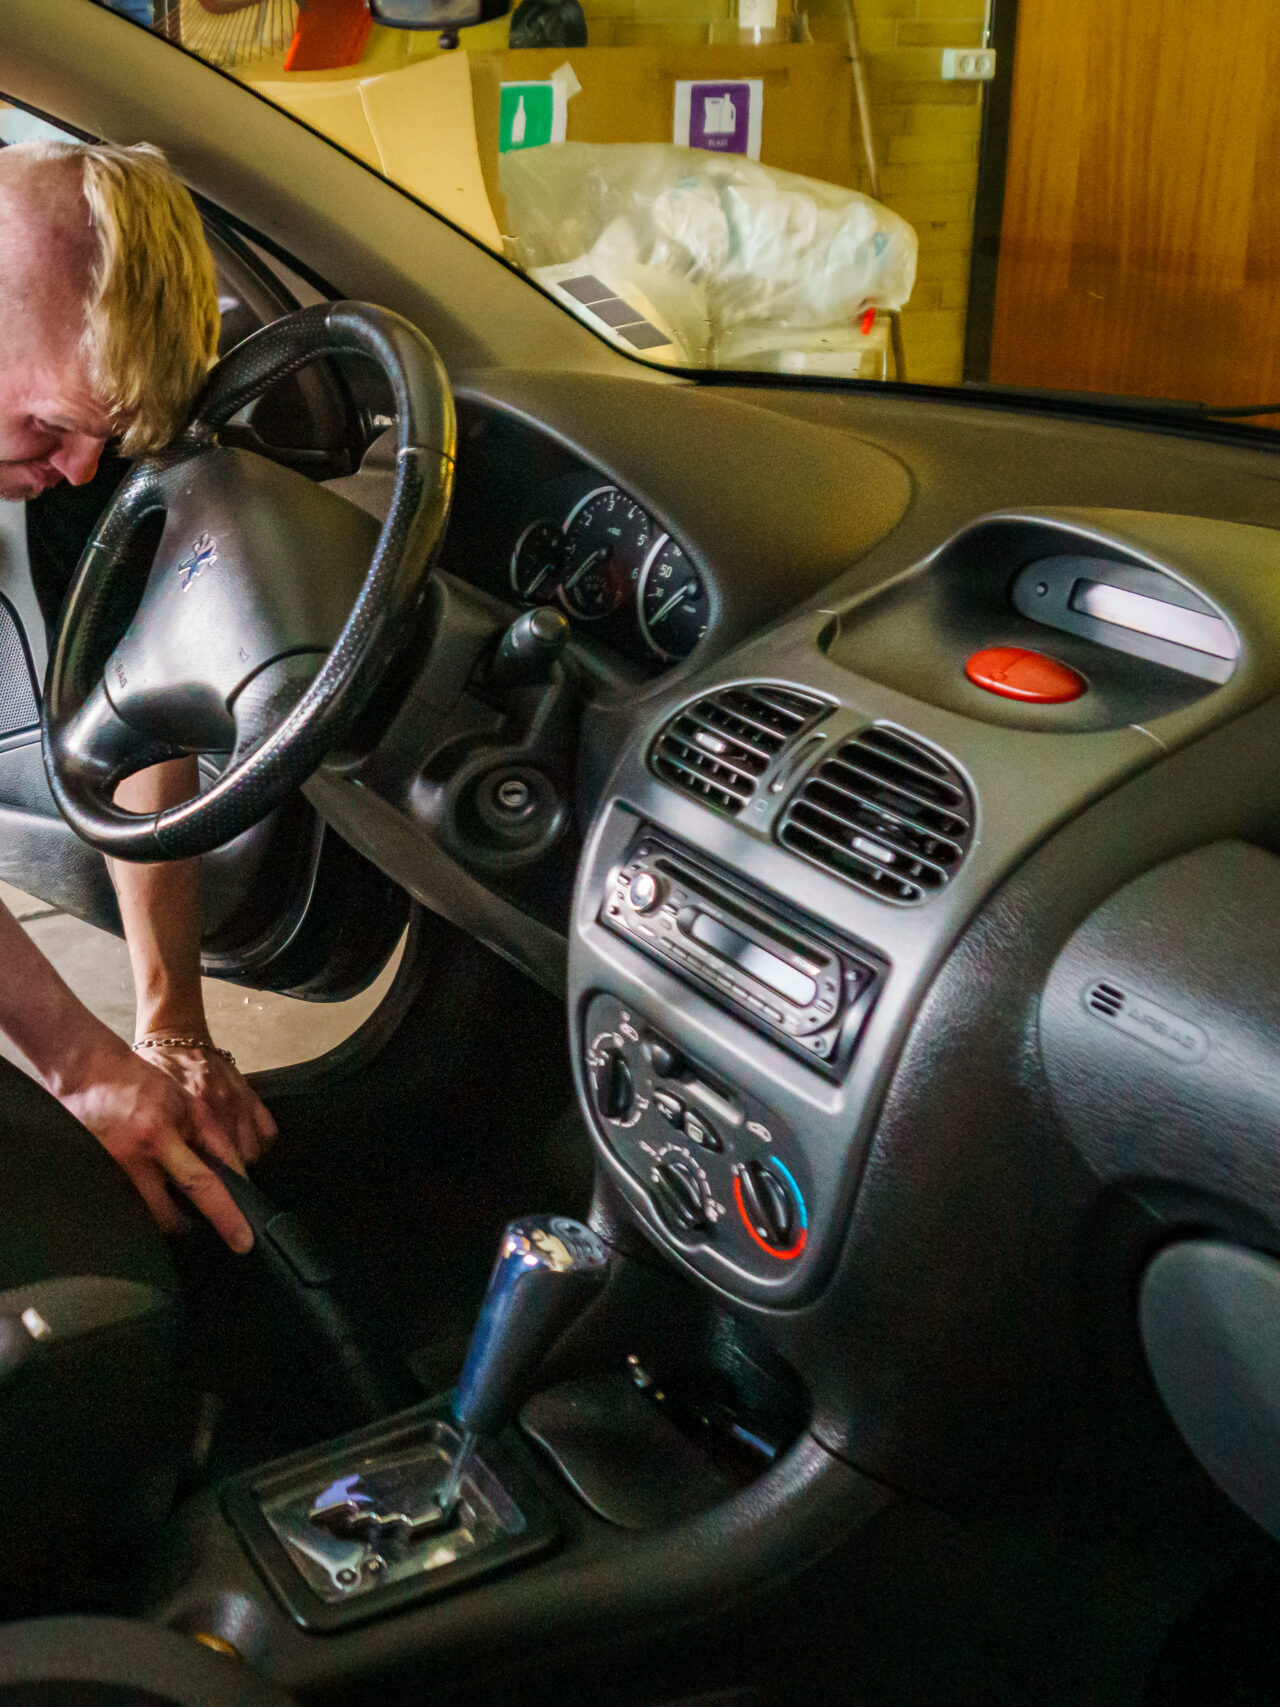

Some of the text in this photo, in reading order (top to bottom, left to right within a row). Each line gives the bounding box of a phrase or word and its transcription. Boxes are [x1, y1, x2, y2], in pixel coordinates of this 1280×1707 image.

[637, 534, 646, 546] 5
[631, 568, 639, 579] 6
[660, 564, 672, 578] 50
